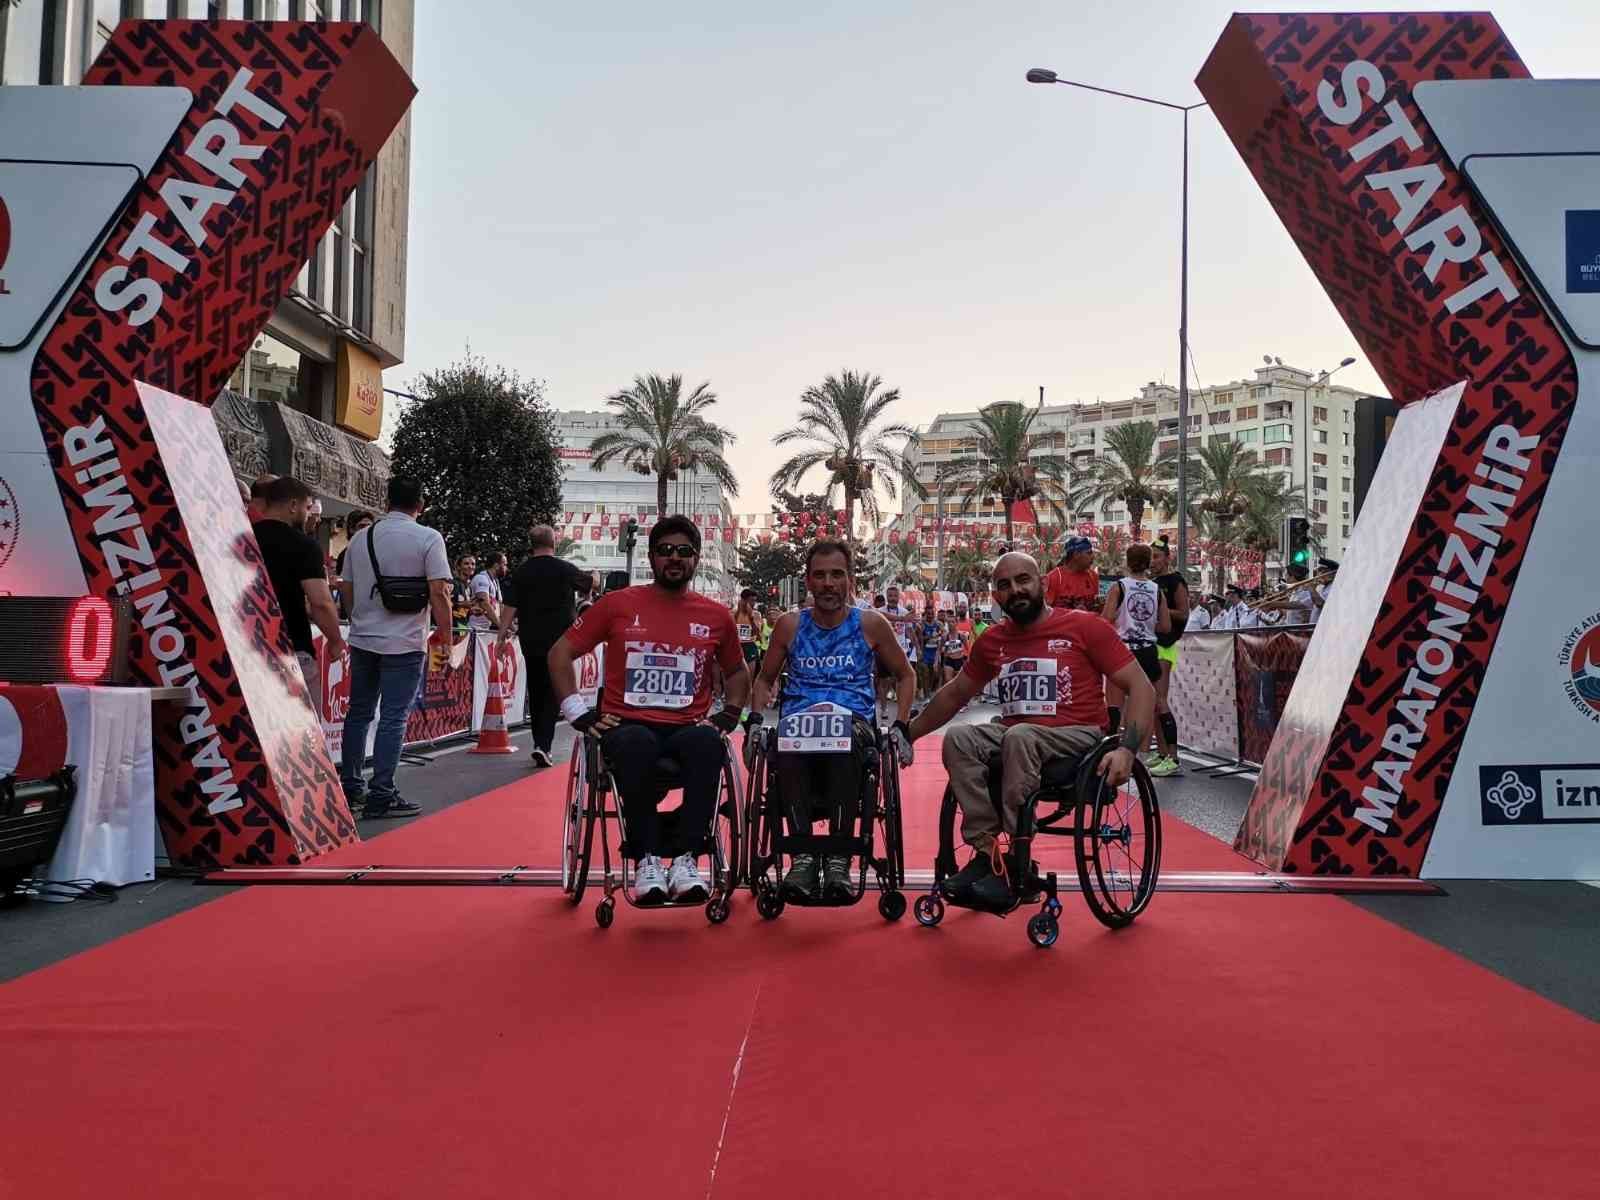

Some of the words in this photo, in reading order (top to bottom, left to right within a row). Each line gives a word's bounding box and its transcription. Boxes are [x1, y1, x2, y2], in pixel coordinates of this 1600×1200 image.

[94, 67, 289, 327] START
[1316, 60, 1521, 314] START
[69, 597, 113, 679] 0
[798, 655, 855, 669] TOYOTA
[632, 670, 688, 695] 2804
[1001, 675, 1049, 702] 3216
[1562, 679, 1593, 717] TURKISH
[786, 715, 845, 737] 3016
